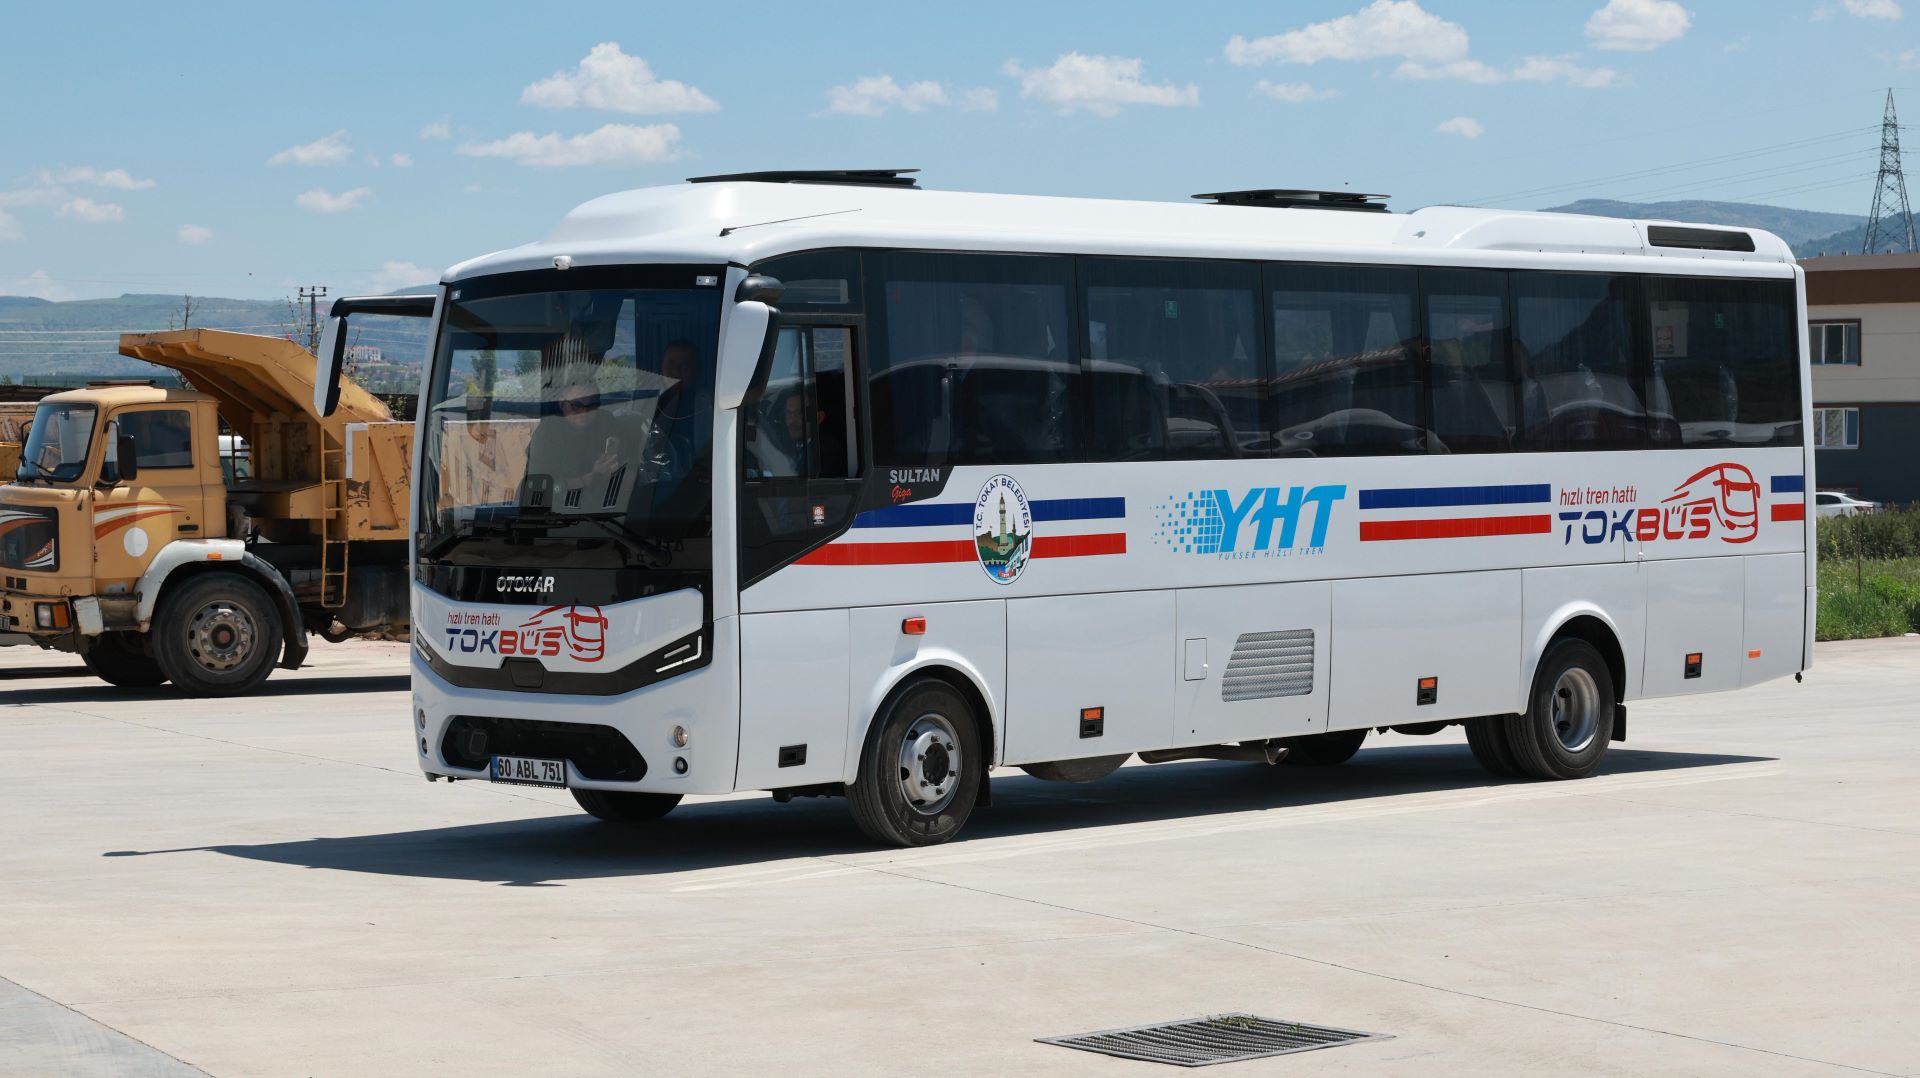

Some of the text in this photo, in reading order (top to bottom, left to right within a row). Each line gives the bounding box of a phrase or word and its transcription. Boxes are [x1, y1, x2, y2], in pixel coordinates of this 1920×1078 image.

[889, 468, 940, 484] SULTAN
[891, 485, 913, 503] Giga
[979, 478, 999, 508] TOKAT
[1559, 485, 1637, 506] hızlı tren hattı
[976, 513, 984, 530] T.C.
[1213, 484, 1347, 552] YHT
[1558, 505, 1713, 546] TOKBÜS
[1299, 547, 1325, 556] TREN
[496, 576, 555, 593] OTOKAR
[447, 611, 500, 626] hızlı tren hattı
[498, 758, 562, 781] 60 ABL 751
